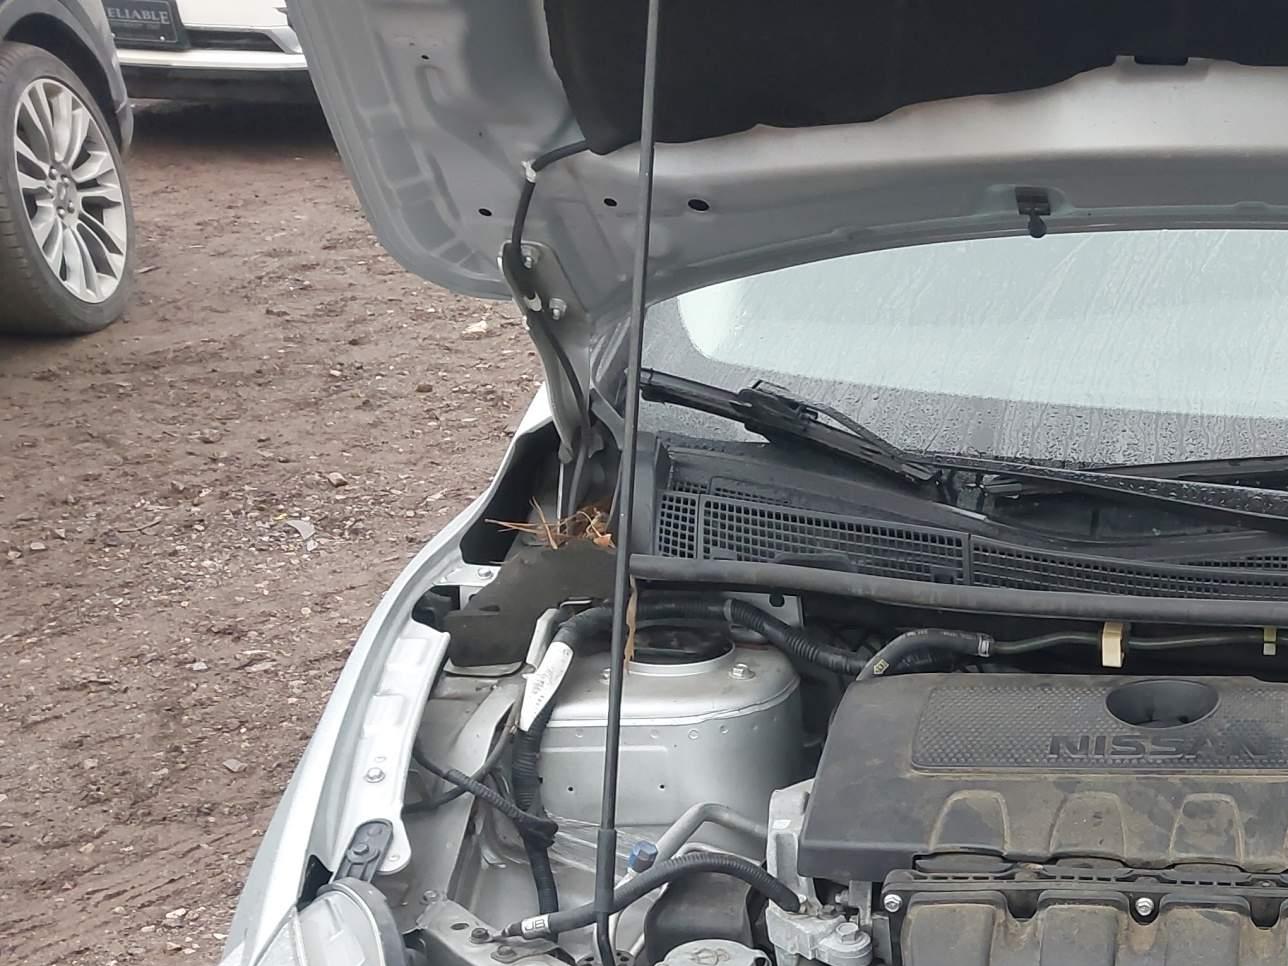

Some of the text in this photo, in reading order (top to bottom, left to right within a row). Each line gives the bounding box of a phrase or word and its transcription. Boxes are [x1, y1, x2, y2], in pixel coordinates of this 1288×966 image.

[105, 7, 170, 24] ELIABLE
[1048, 734, 1272, 759] NISSAN
[524, 918, 546, 931] JB
